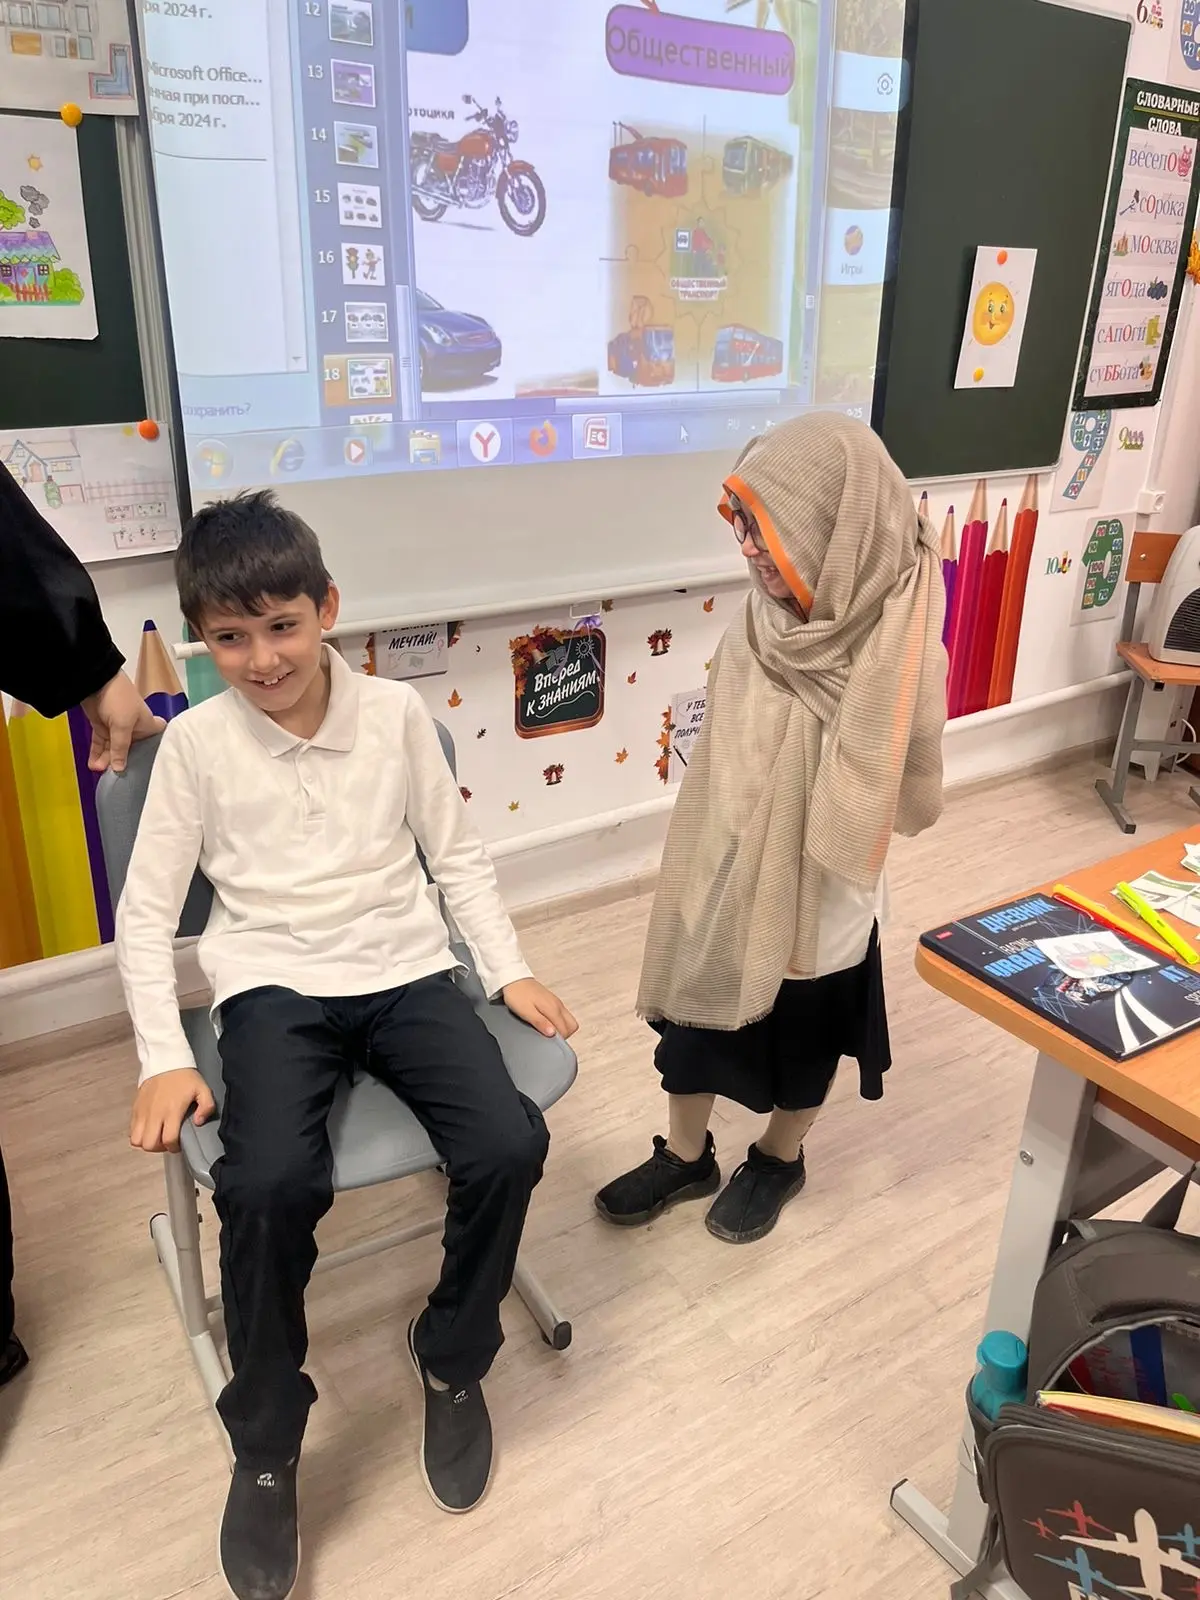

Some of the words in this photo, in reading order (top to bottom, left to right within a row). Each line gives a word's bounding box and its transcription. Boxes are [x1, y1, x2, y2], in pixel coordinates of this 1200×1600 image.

[163, 2, 197, 17] 2024
[305, 2, 321, 17] 12
[308, 65, 323, 79] 13
[183, 93, 209, 106] при
[1137, 91, 1199, 116] СЛОВАРНЫЕ
[178, 112, 211, 128] 2024
[1148, 117, 1182, 136] СЛОВА
[311, 127, 327, 142] 14
[315, 190, 330, 203] 15
[318, 251, 334, 264] 16
[322, 310, 337, 323] 17
[325, 368, 340, 381] 18
[1118, 427, 1128, 450] 9
[1044, 557, 1058, 575] 10
[388, 631, 438, 650] МЕЧТАЙ!
[686, 702, 693, 711] У
[977, 898, 1057, 933] ДНЕВНИК
[984, 947, 1046, 977] URBA
